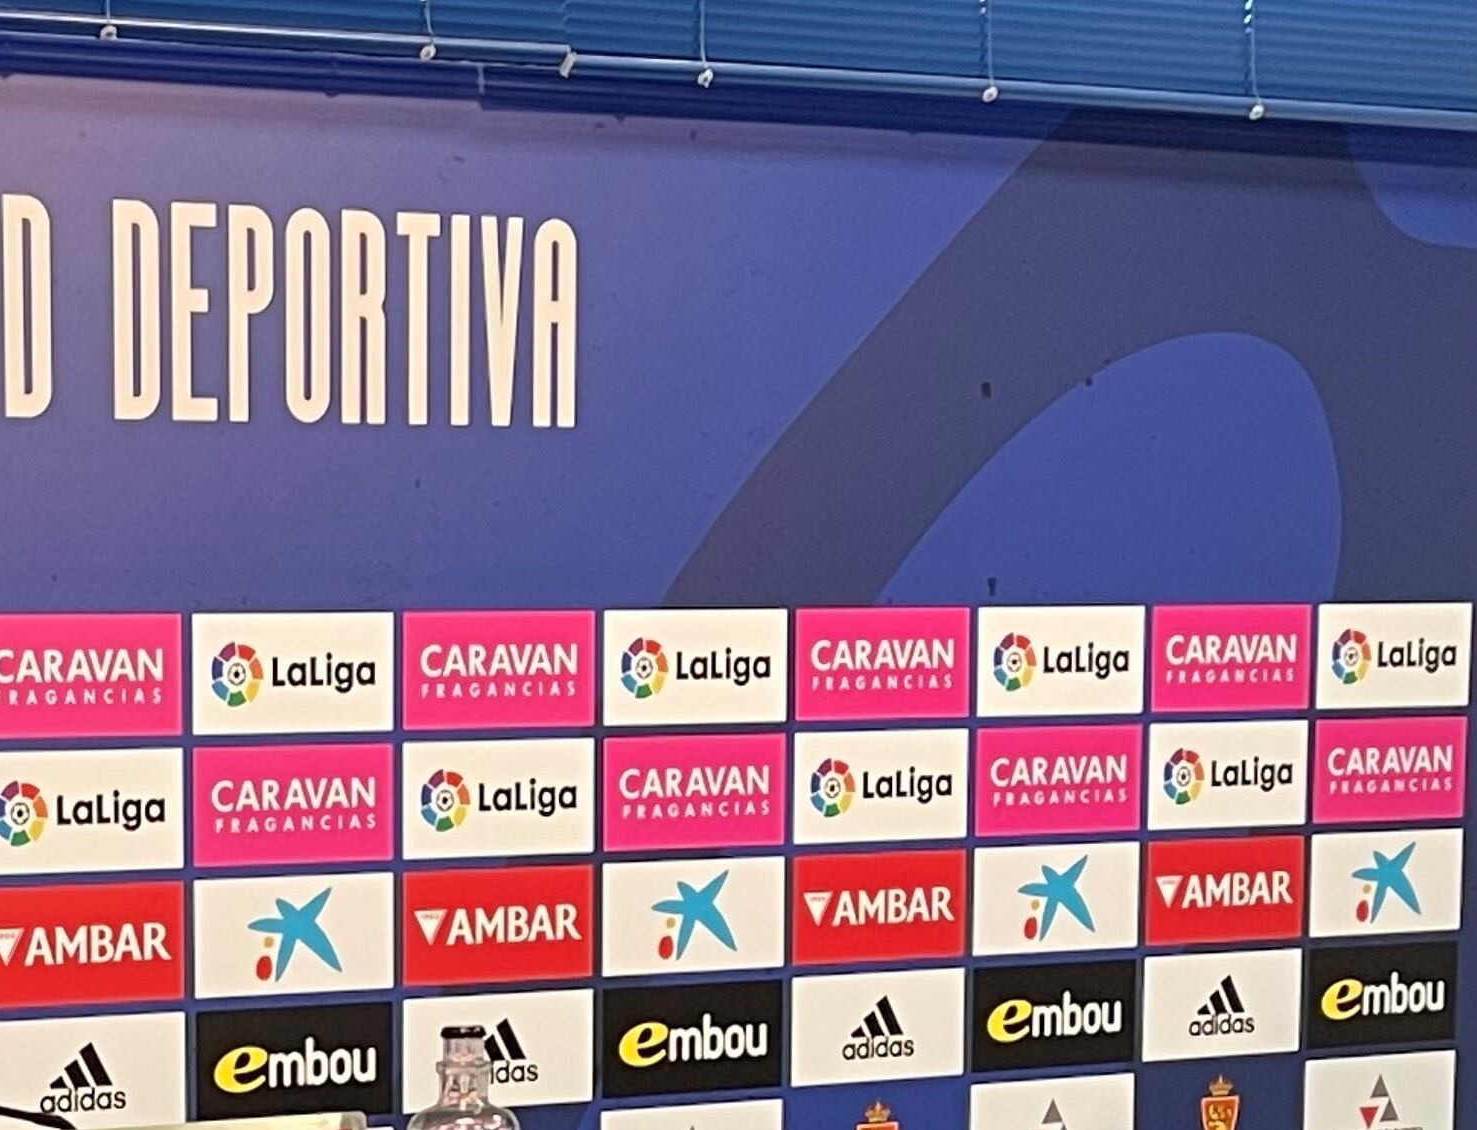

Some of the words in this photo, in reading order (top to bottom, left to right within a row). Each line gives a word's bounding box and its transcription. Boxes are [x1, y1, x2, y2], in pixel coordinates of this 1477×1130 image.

[112, 198, 577, 428] DEPORTIVA
[420, 643, 578, 678] CARAVAN
[676, 647, 771, 687] LaLiga
[810, 638, 954, 671] CARAVAN
[1043, 641, 1130, 680] LaLiga
[1165, 634, 1297, 666] CARAVAN
[1377, 637, 1457, 674] LaLiga
[272, 651, 376, 694] LaLiga
[421, 680, 576, 698] FRAGANCIAS
[812, 673, 952, 691] FRAGANCIAS
[1166, 667, 1294, 684] FRAGANCIAS
[990, 754, 1127, 788] CARAVAN
[1210, 756, 1293, 793] LaLiga
[1327, 744, 1453, 777] CARAVAN
[211, 776, 376, 813] CARAVAN
[478, 777, 577, 817] LaLiga
[619, 765, 770, 800] CARAVAN
[862, 765, 953, 805] LaLiga
[993, 788, 1127, 807] FRAGANCIAS
[1329, 776, 1452, 795] FRAGANCIAS
[56, 789, 166, 832] LaLiga
[215, 812, 376, 834] FRAGANCIAS
[622, 800, 770, 819] FRAGANCIAS
[832, 886, 955, 927] AMBAR
[1181, 870, 1293, 909] AMBAR
[446, 903, 582, 946] AMBAR
[24, 922, 172, 966] AMBAR
[1320, 971, 1445, 1020] embou
[986, 990, 1122, 1043] embou
[1188, 1012, 1255, 1037] adidas
[618, 1013, 768, 1067] embou
[841, 1036, 915, 1061] adidas
[213, 1036, 377, 1094] embou
[39, 1084, 127, 1115] adidas
